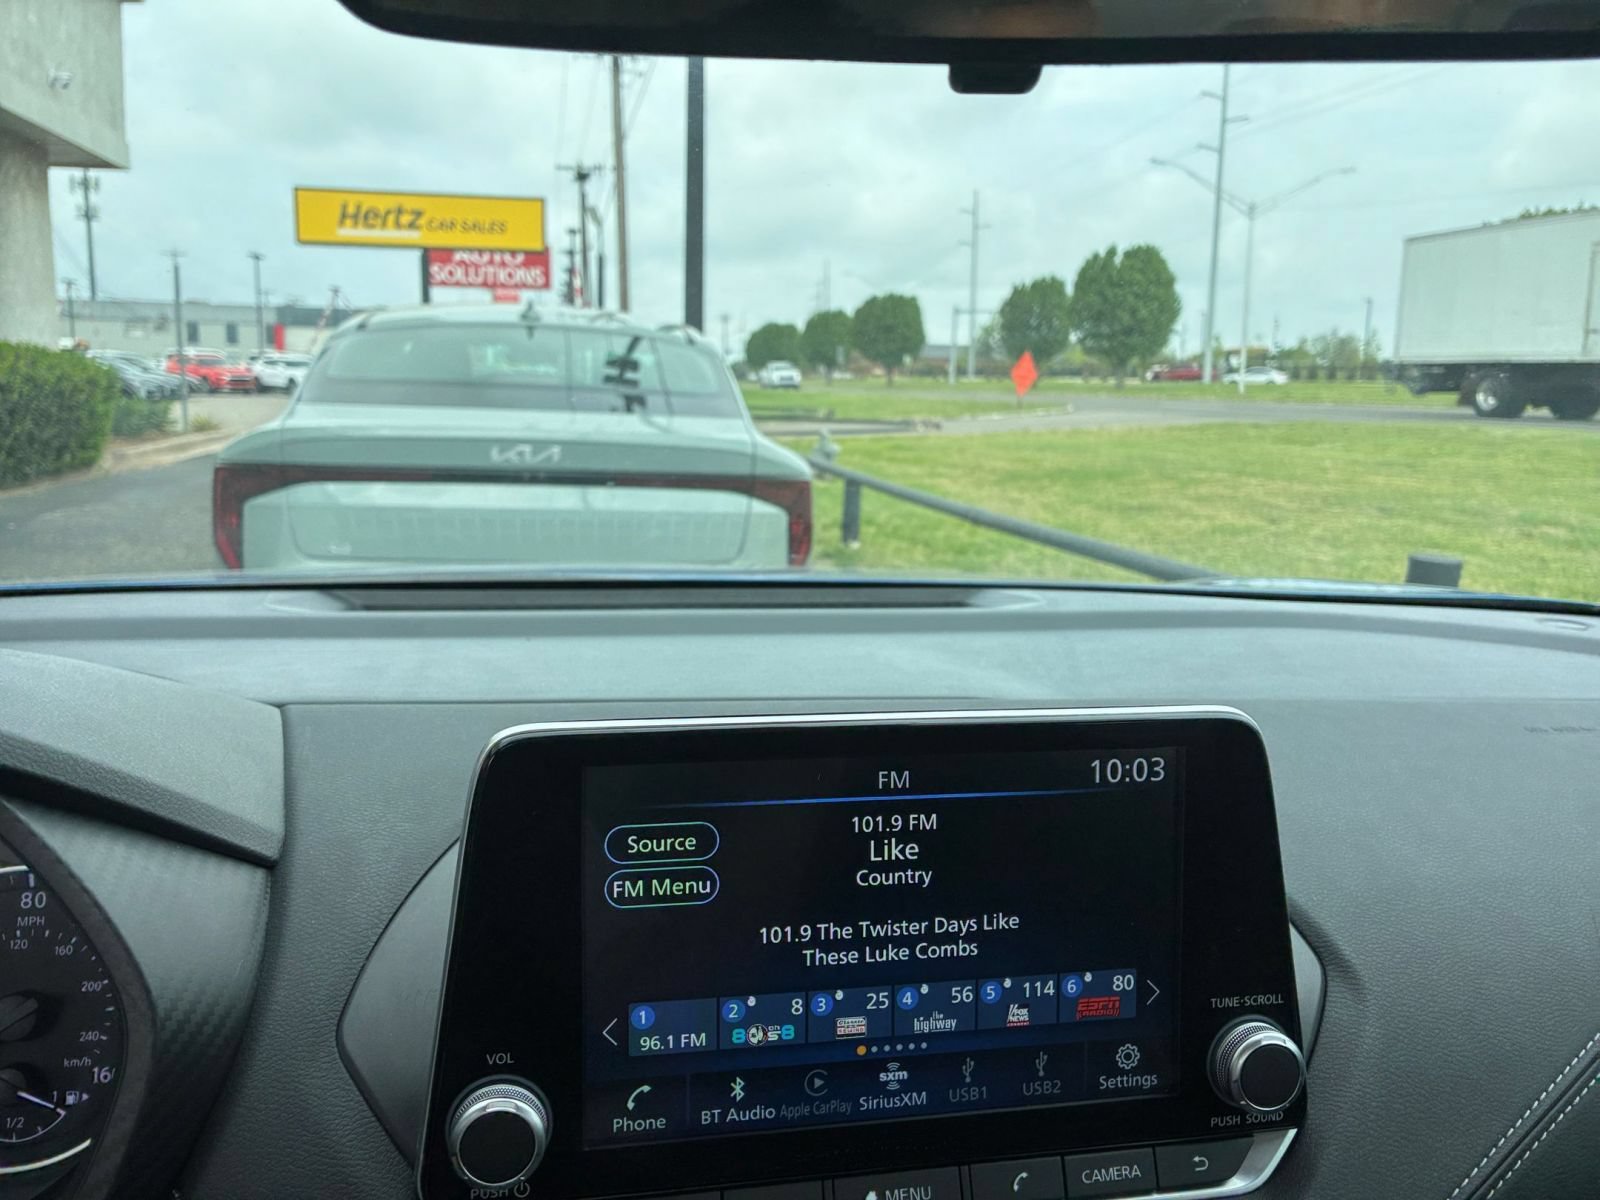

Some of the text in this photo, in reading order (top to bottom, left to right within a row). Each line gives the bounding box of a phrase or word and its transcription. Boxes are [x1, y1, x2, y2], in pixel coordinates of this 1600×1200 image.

[337, 201, 507, 234] Hertz CAR SALES
[430, 263, 545, 287] SOLUTIONS
[490, 443, 562, 464] KIA
[1091, 757, 1165, 783] 10:03
[879, 771, 910, 789] FM
[852, 813, 937, 833] 101.9 FM
[627, 835, 697, 853] Source
[870, 837, 919, 861] Like
[856, 868, 933, 888] Country
[613, 878, 711, 898] FM Menu
[20, 891, 47, 909] 80
[17, 916, 46, 927] MPH
[759, 912, 1020, 944] 101.9 The Twister Days Like
[10, 939, 28, 950] 120
[55, 945, 73, 956] 160
[802, 940, 978, 966] These Luke Combs
[81, 981, 102, 992] 200
[1023, 980, 1055, 998] 114
[1067, 979, 1077, 993] 6
[1113, 974, 1134, 991] 80
[866, 991, 889, 1010] 25
[902, 991, 913, 1005] 4
[951, 986, 974, 1004] 56
[986, 985, 996, 1000] 5
[728, 1004, 739, 1018] 2
[791, 998, 803, 1015] 8
[816, 997, 826, 1012] 3
[1077, 996, 1120, 1010] ESPN
[638, 1010, 647, 1025] 1
[932, 1010, 944, 1019] the
[914, 1016, 957, 1033] highway
[80, 1031, 99, 1042] 240
[640, 1032, 706, 1051] 96.1 FM
[63, 1057, 92, 1068] km/h
[486, 1053, 515, 1064] VOL
[1023, 1080, 1061, 1096] USB2
[1099, 1073, 1158, 1090] Settings
[859, 1091, 927, 1111] SiriusXM
[949, 1086, 987, 1102] USB1
[701, 1105, 776, 1125] BT Audio
[780, 1097, 853, 1119] Apple CarPlay
[6, 1117, 24, 1128] 1/2
[613, 1117, 667, 1132] Phone
[1211, 1110, 1284, 1128] PUSH SOUND
[1081, 1164, 1141, 1184] CAMERA
[470, 1188, 509, 1199] PUSH
[885, 1186, 931, 1200] MENU
